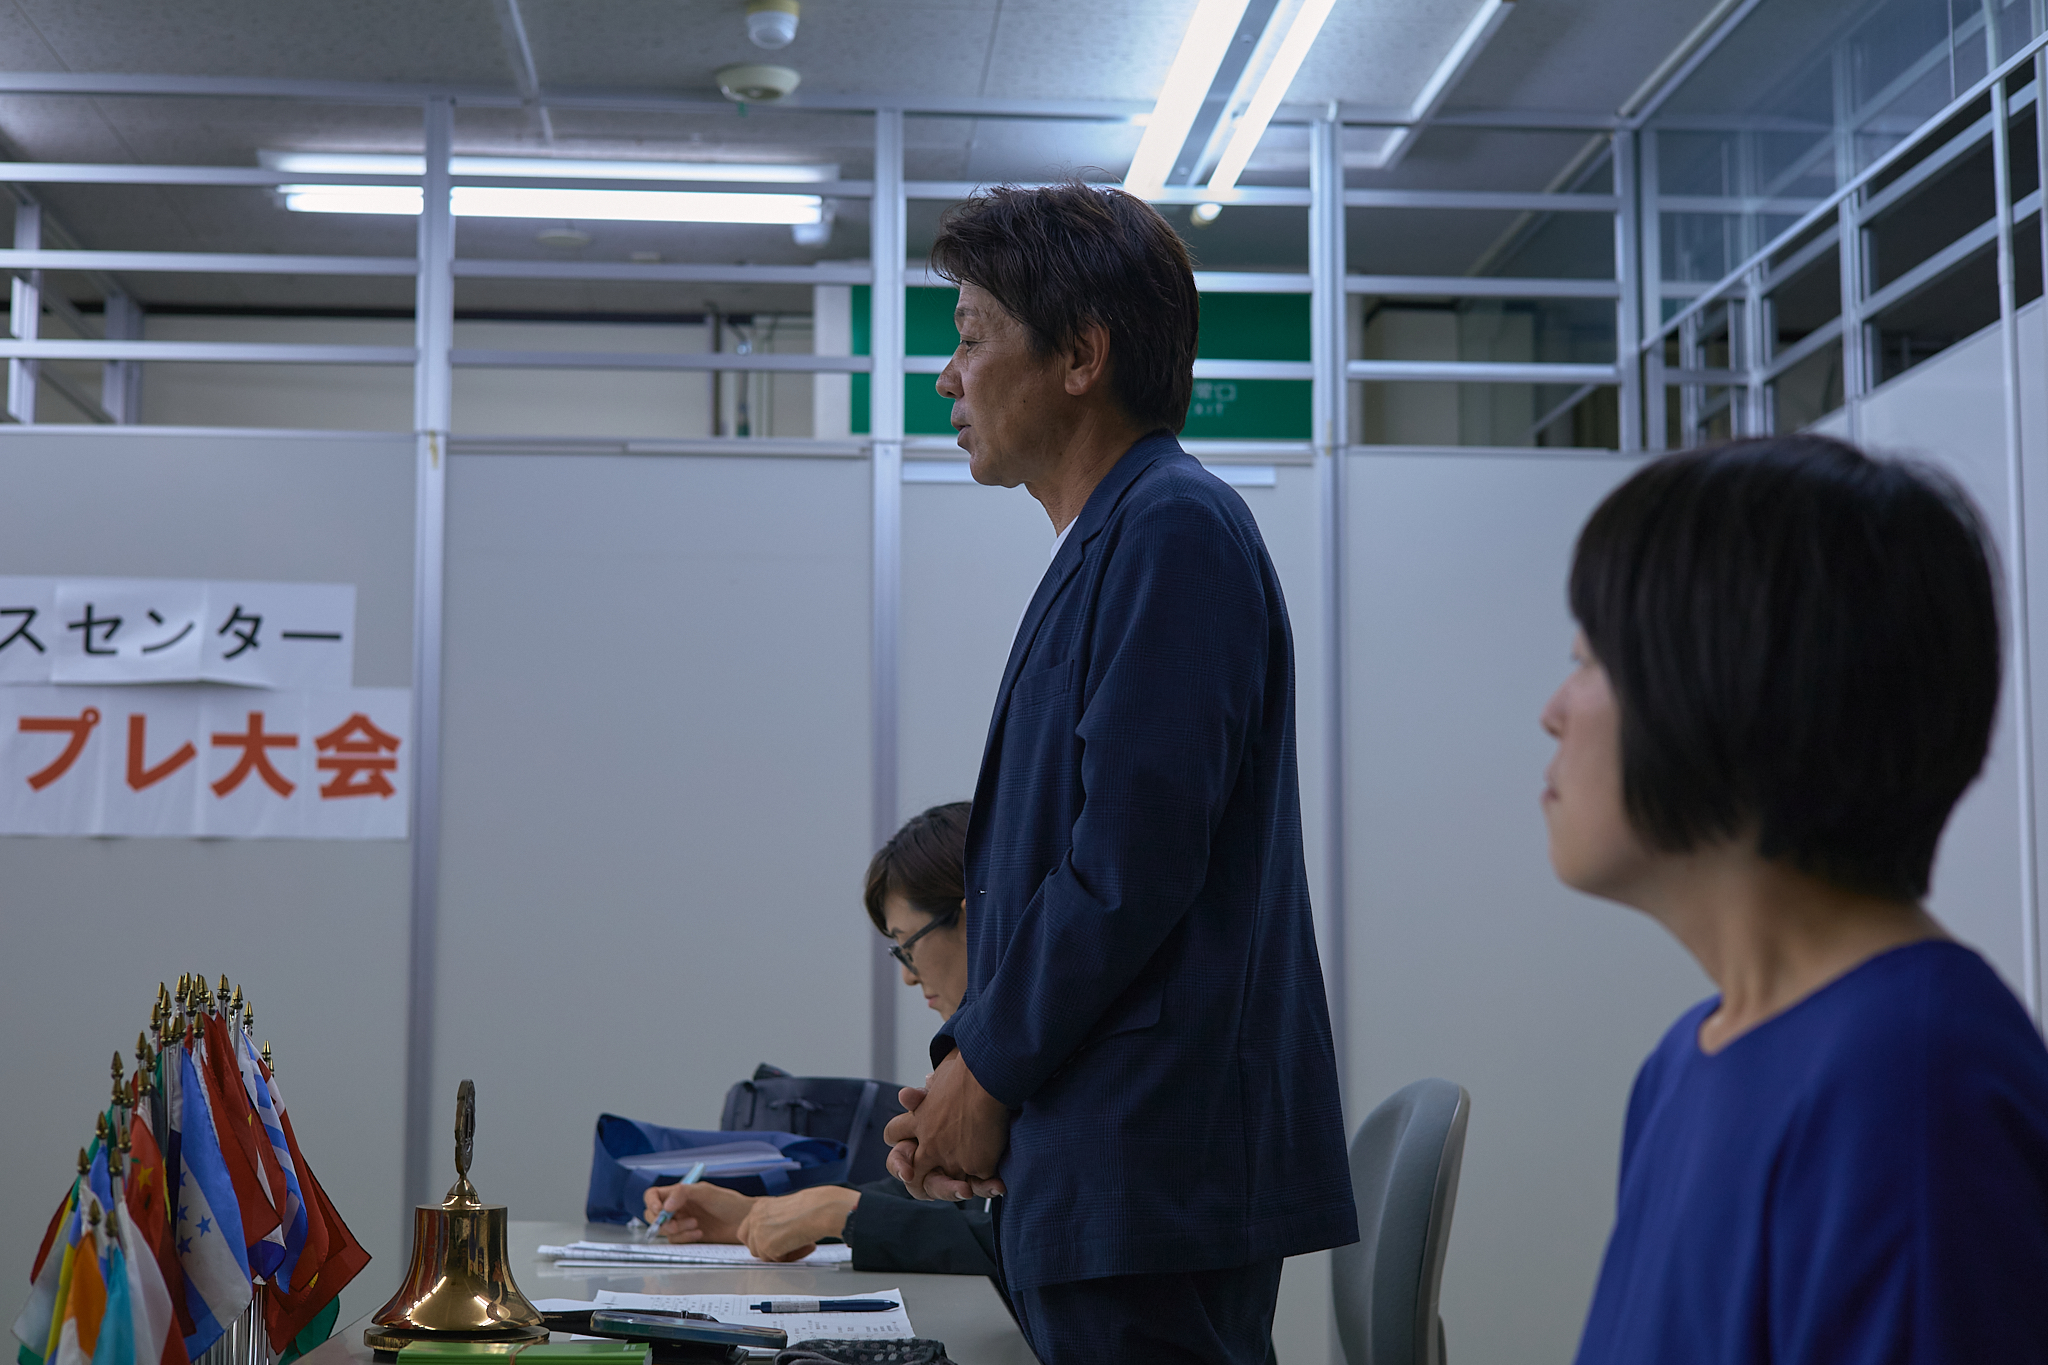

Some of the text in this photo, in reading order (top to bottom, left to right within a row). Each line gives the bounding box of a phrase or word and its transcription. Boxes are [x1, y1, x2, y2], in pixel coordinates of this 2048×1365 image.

[0, 604, 343, 660] スセンター
[18, 706, 401, 800] プレ大会
